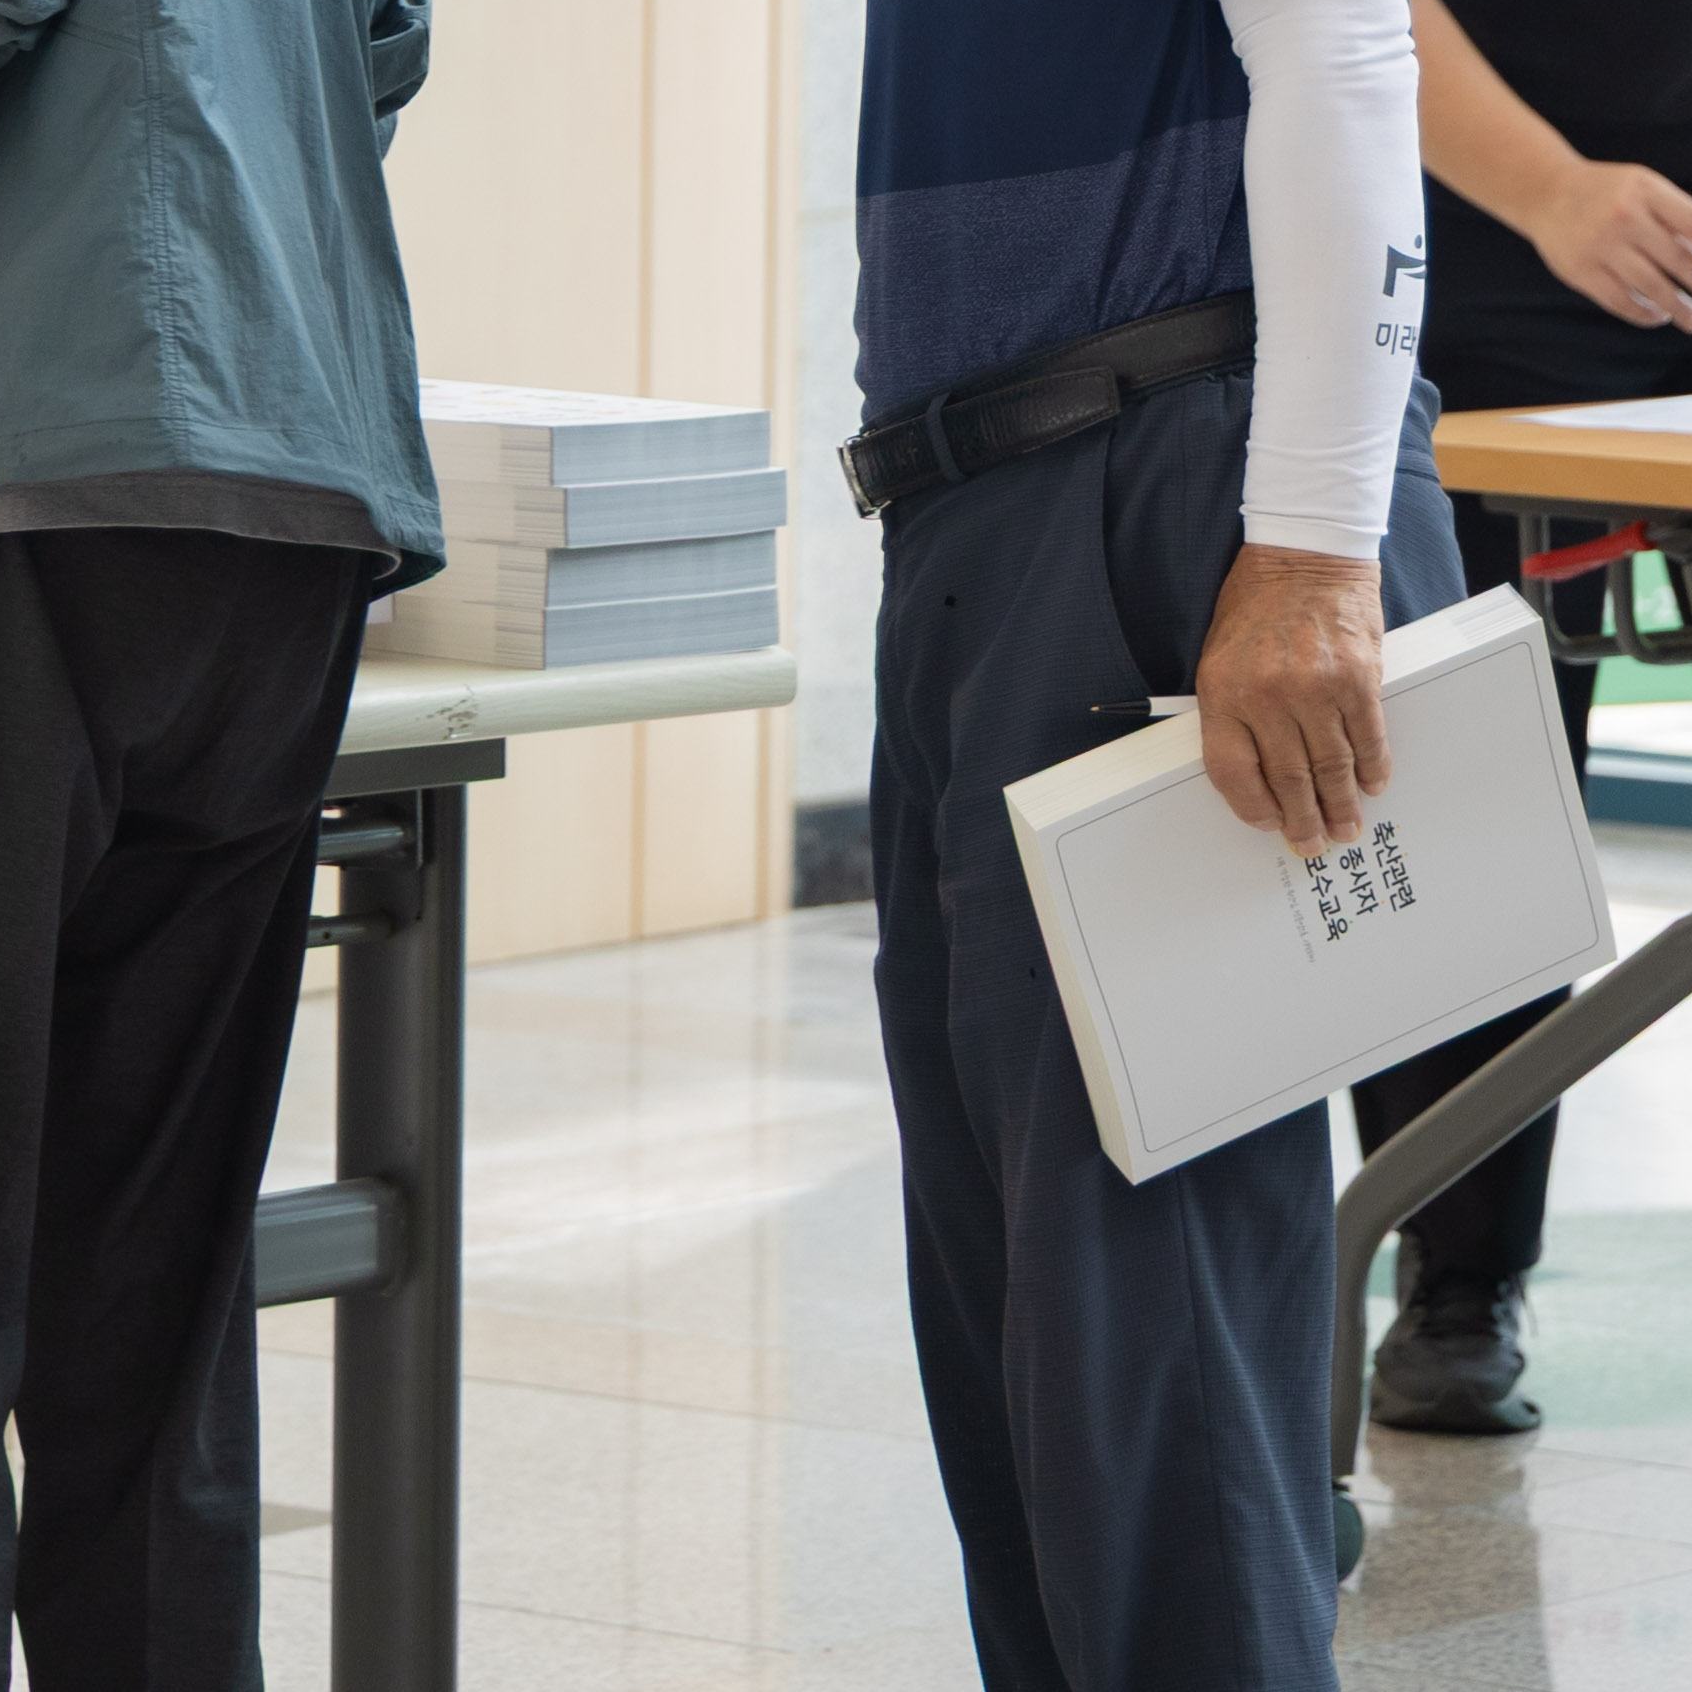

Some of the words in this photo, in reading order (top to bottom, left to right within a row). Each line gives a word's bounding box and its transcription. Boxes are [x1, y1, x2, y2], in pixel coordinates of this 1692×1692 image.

[1305, 855, 1348, 942] 보수교육
[1339, 847, 1379, 916] 종사자
[1372, 821, 1416, 912] 축산관련
